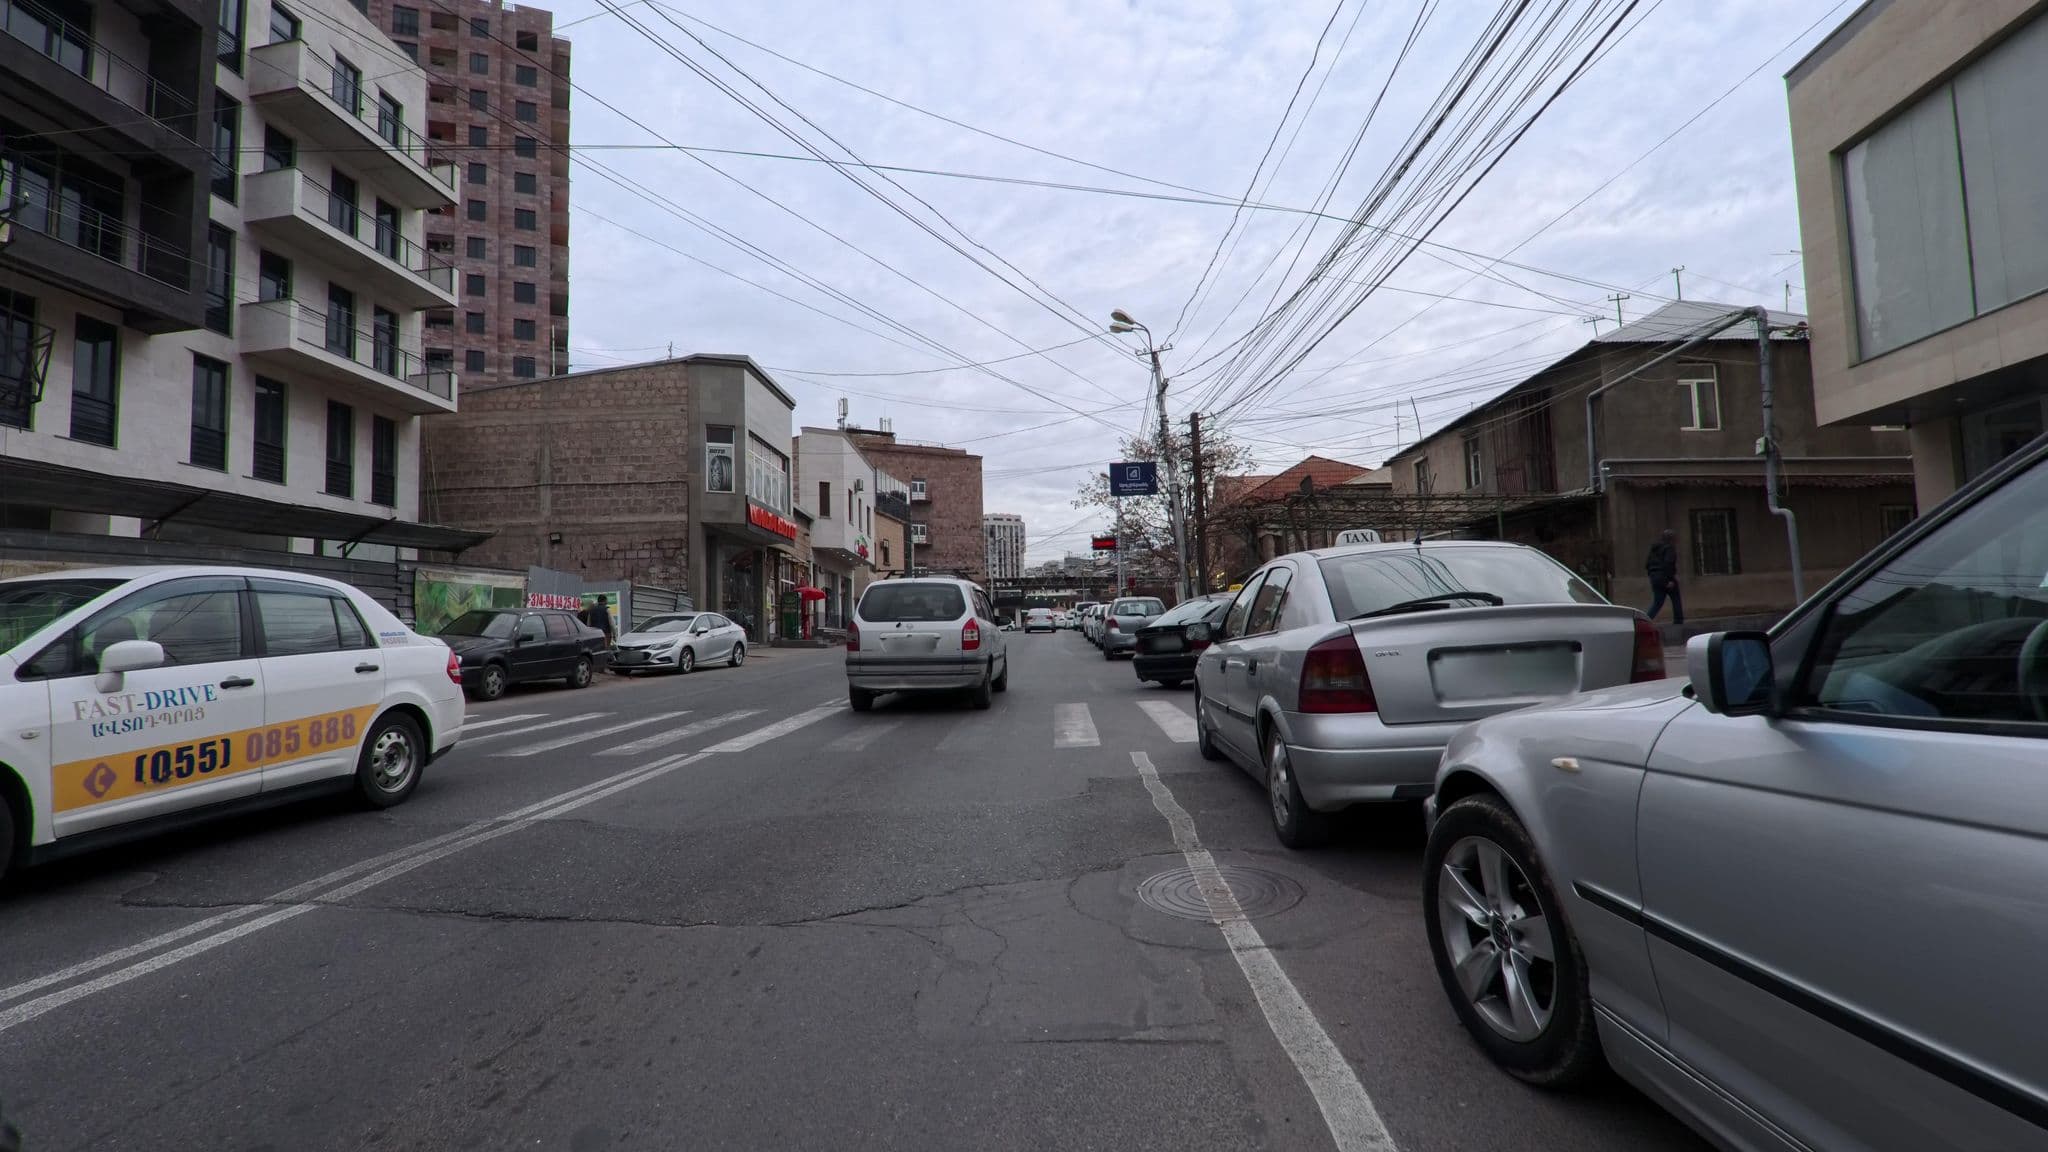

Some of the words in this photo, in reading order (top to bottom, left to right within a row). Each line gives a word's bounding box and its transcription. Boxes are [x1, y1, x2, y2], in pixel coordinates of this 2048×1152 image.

[1344, 531, 1375, 544] TAXI
[72, 684, 217, 720] FAST-DRIVE
[135, 738, 231, 785] (055)
[245, 725, 300, 764] 085
[307, 713, 355, 748] 888
